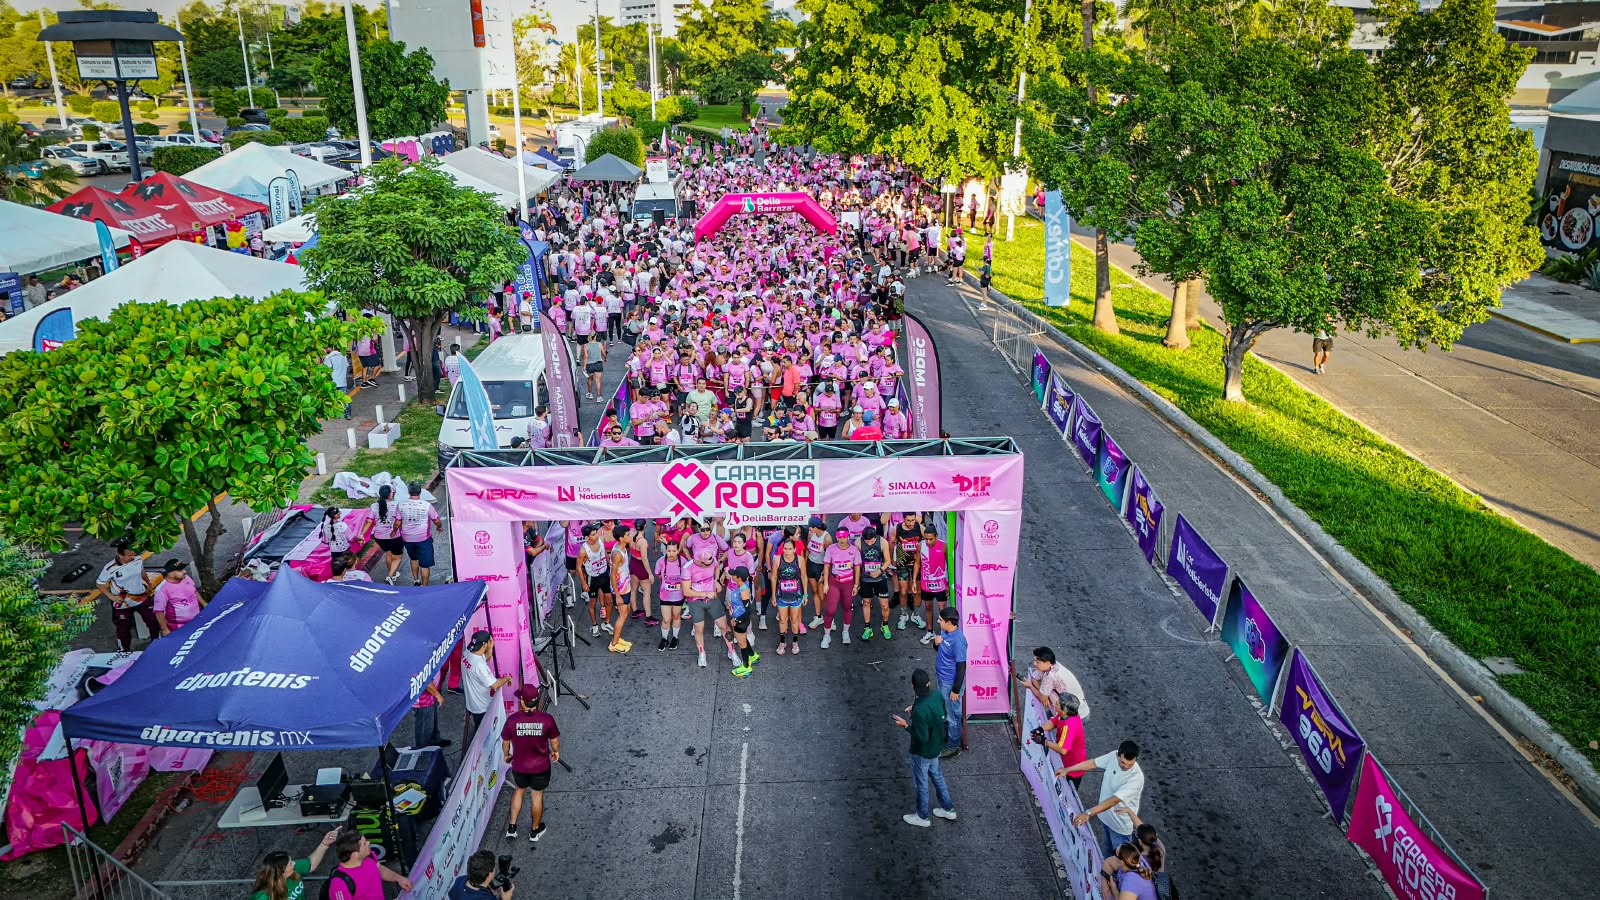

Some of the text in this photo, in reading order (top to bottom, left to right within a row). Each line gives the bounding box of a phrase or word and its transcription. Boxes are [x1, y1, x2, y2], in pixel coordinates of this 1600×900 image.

[188, 196, 235, 216] TECATE
[756, 197, 781, 205] Delia
[757, 205, 793, 213] Barraza
[120, 213, 176, 234] TECATE
[714, 464, 815, 481] CARRERA
[888, 481, 937, 490] SINALOA
[954, 474, 991, 492] DIF
[465, 488, 537, 501] VIBRA
[578, 492, 631, 501] Noticieristas
[714, 481, 815, 509] ROSA
[742, 514, 804, 523] DeliaBarraza
[349, 602, 412, 673] dportenis
[175, 667, 311, 692] dportenis
[971, 684, 998, 697] DIF
[1295, 684, 1346, 764] VIBRA
[140, 725, 314, 746] dportenis.mx
[1298, 712, 1332, 774] 96.9
[1393, 825, 1456, 899] CARRERA
